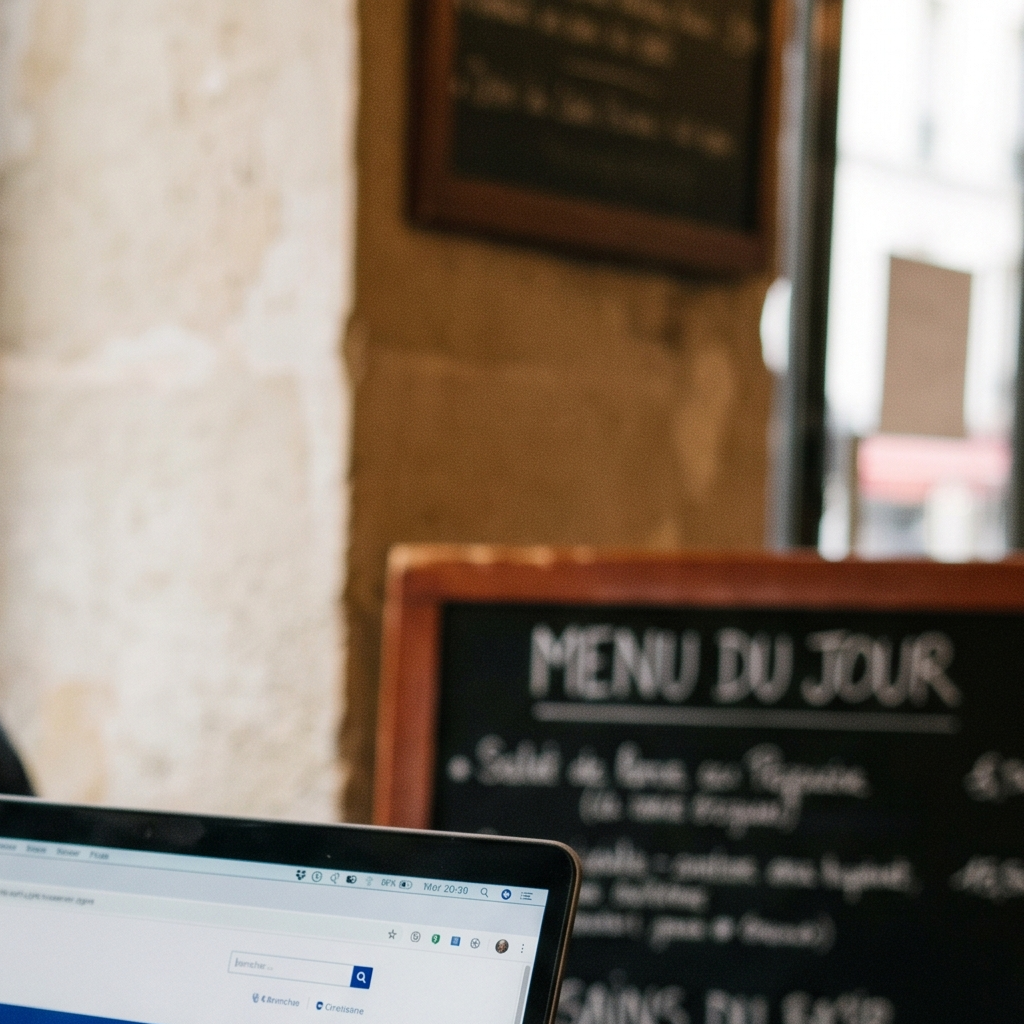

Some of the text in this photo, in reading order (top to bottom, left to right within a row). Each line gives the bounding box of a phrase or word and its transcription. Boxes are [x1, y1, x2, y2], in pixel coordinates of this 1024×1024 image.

[529, 623, 963, 707] MENU DU JOUR
[443, 884, 469, 895] 20:30
